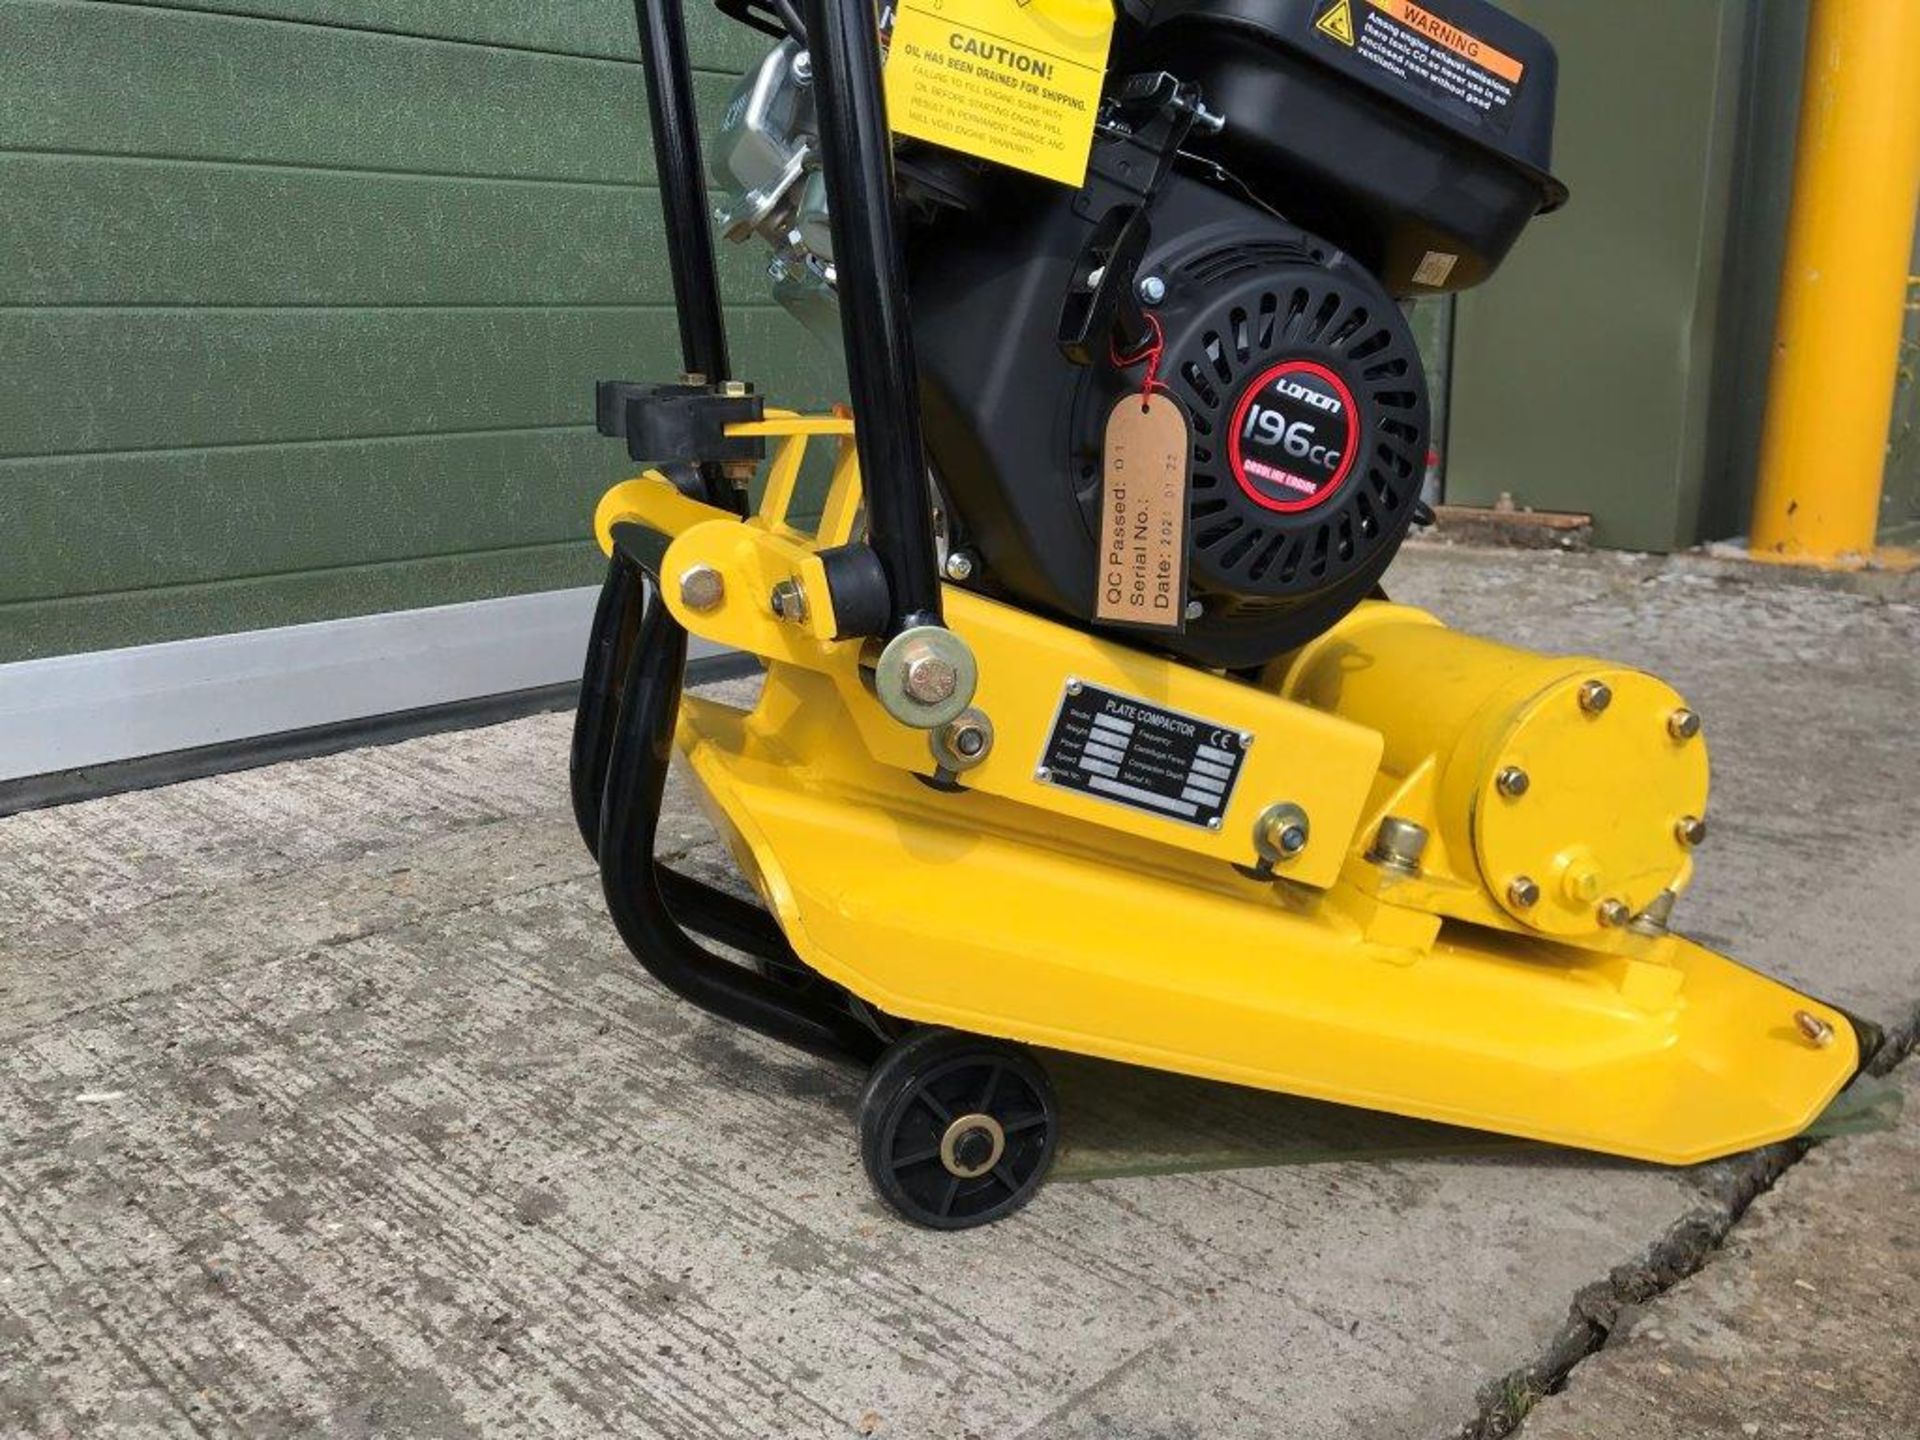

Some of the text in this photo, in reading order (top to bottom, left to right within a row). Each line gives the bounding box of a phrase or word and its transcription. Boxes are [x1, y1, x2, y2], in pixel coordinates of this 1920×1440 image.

[949, 32, 1053, 81] CAUTION!
[1399, 31, 1429, 52] engine
[1430, 48, 1465, 71] exhaust
[1403, 5, 1479, 57] WARNING
[904, 43, 1085, 111] OIL HAS BEEN DRAINED FOR SHIPPING.
[983, 87, 1012, 103] ENGINE
[1360, 35, 1491, 109] enclosed room without good
[1388, 36, 1411, 55] toxic
[1411, 49, 1427, 63] CO
[1440, 66, 1466, 84] never
[1466, 80, 1483, 93] use
[1483, 87, 1494, 99] in
[1493, 94, 1506, 105] an
[968, 98, 1009, 117] STARTING
[1010, 111, 1041, 127] ENGINE
[1109, 482, 1126, 565] Passed:
[1106, 571, 1122, 604] QC
[1129, 546, 1146, 606] Serial
[1154, 553, 1171, 608] Date:
[1105, 699, 1195, 736] PLATE COMPACTOR
